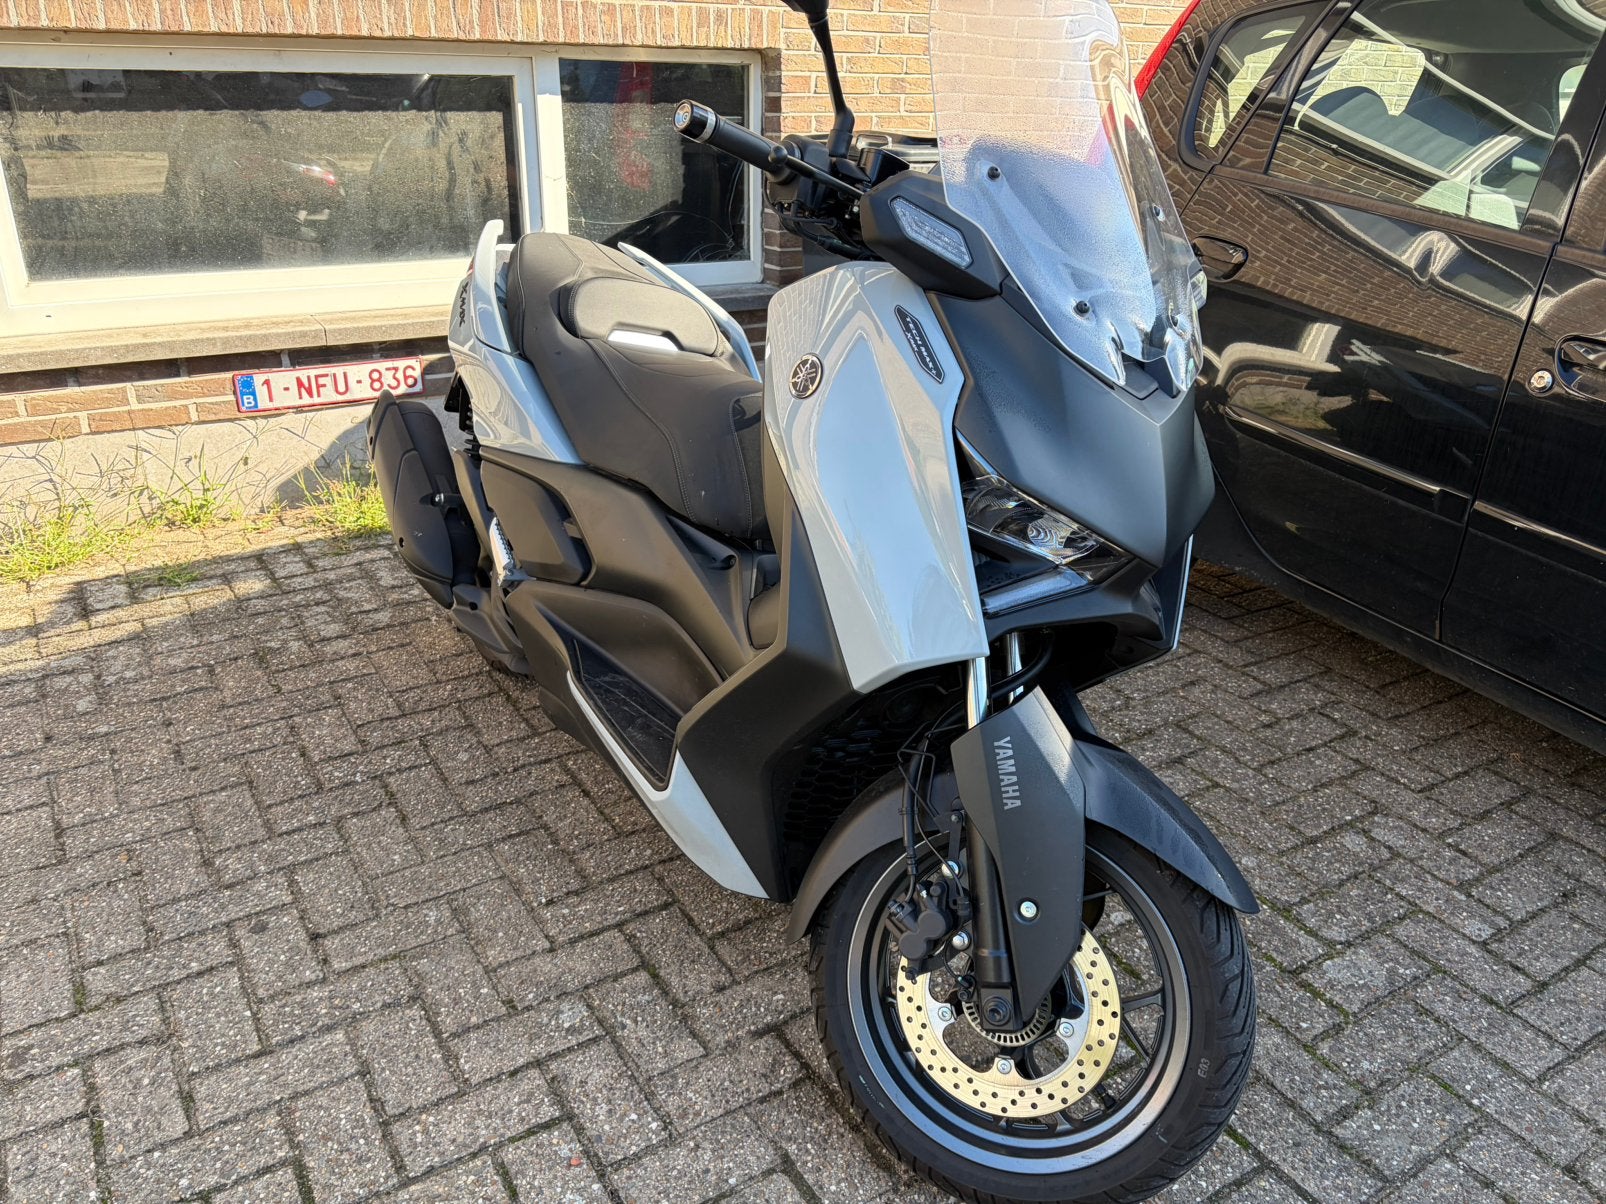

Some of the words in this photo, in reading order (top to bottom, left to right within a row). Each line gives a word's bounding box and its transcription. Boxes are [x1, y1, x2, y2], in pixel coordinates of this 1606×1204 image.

[906, 316, 922, 345] TECH
[243, 395, 256, 408] B
[993, 735, 1022, 811] YAMAHA
